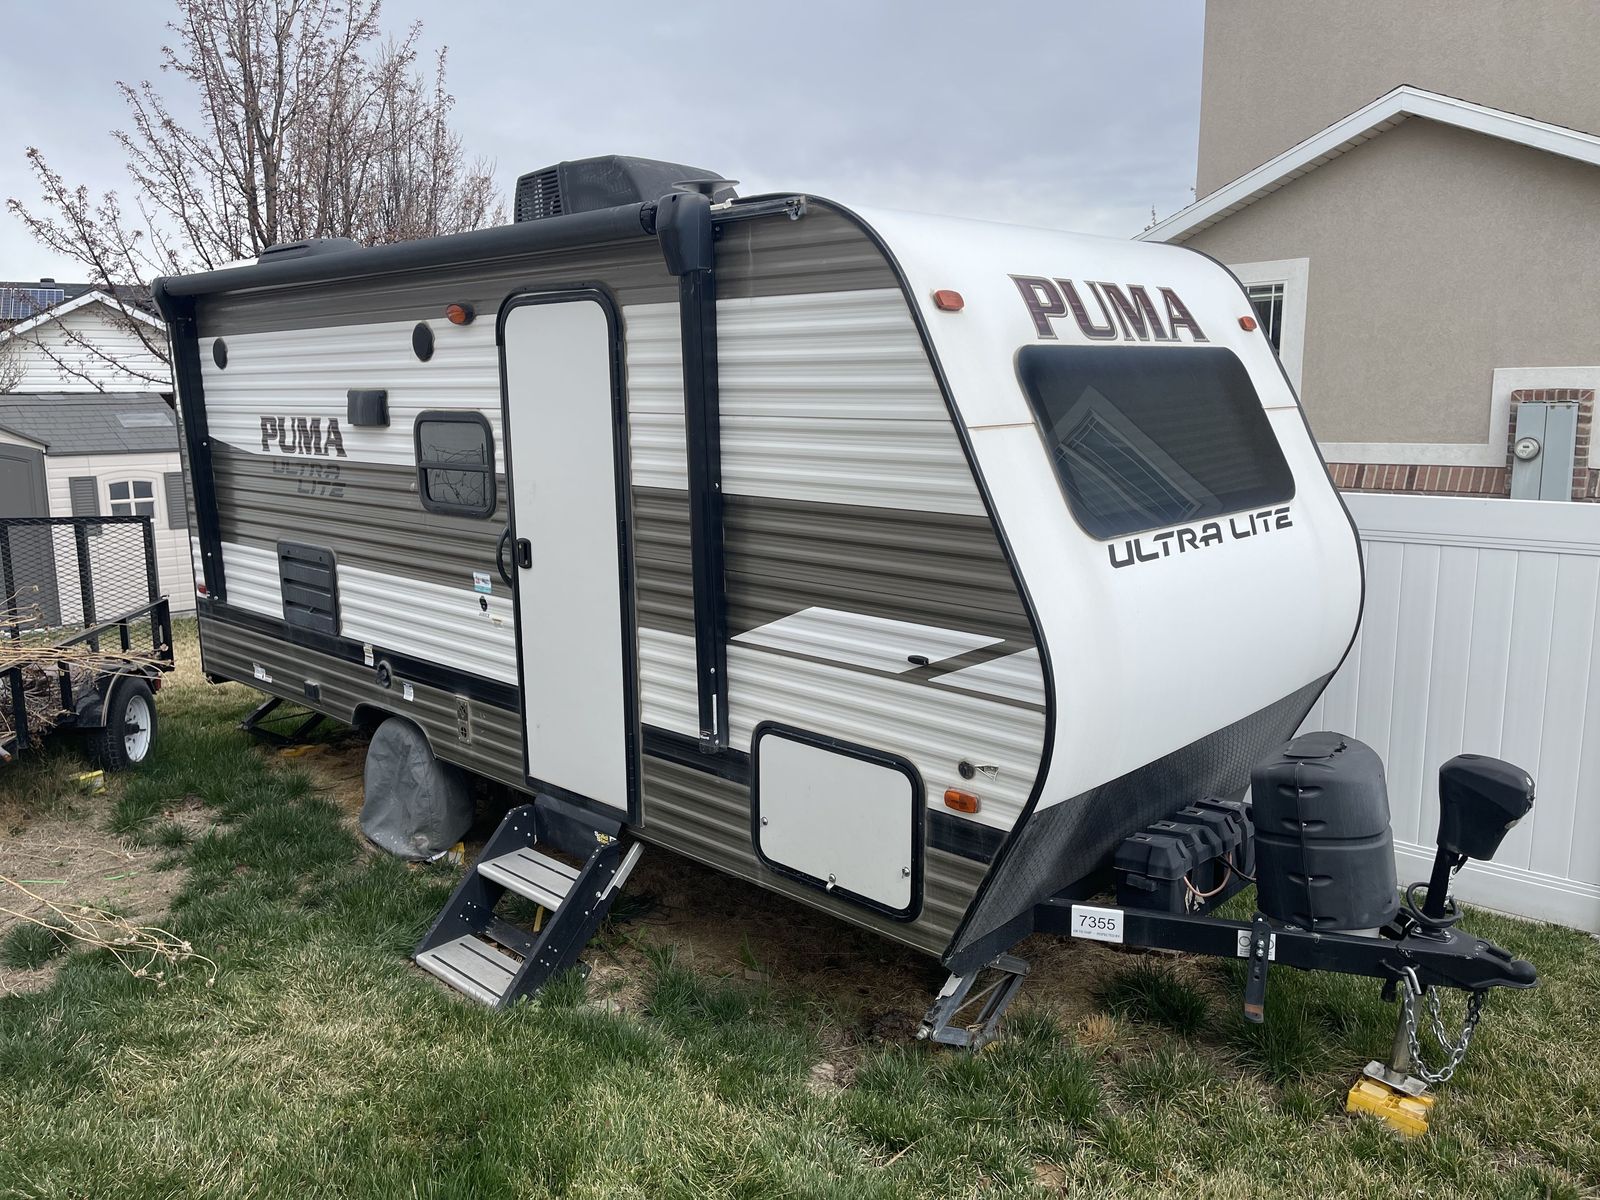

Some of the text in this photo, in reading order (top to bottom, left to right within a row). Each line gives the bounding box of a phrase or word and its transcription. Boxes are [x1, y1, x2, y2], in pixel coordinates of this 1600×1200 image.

[1007, 273, 1210, 343] PUMA
[260, 416, 347, 457] PUMA
[272, 459, 340, 479] ULTRA
[297, 479, 346, 498] LITE
[1108, 506, 1293, 569] ULTRA LITE
[1079, 914, 1116, 931] 7355
